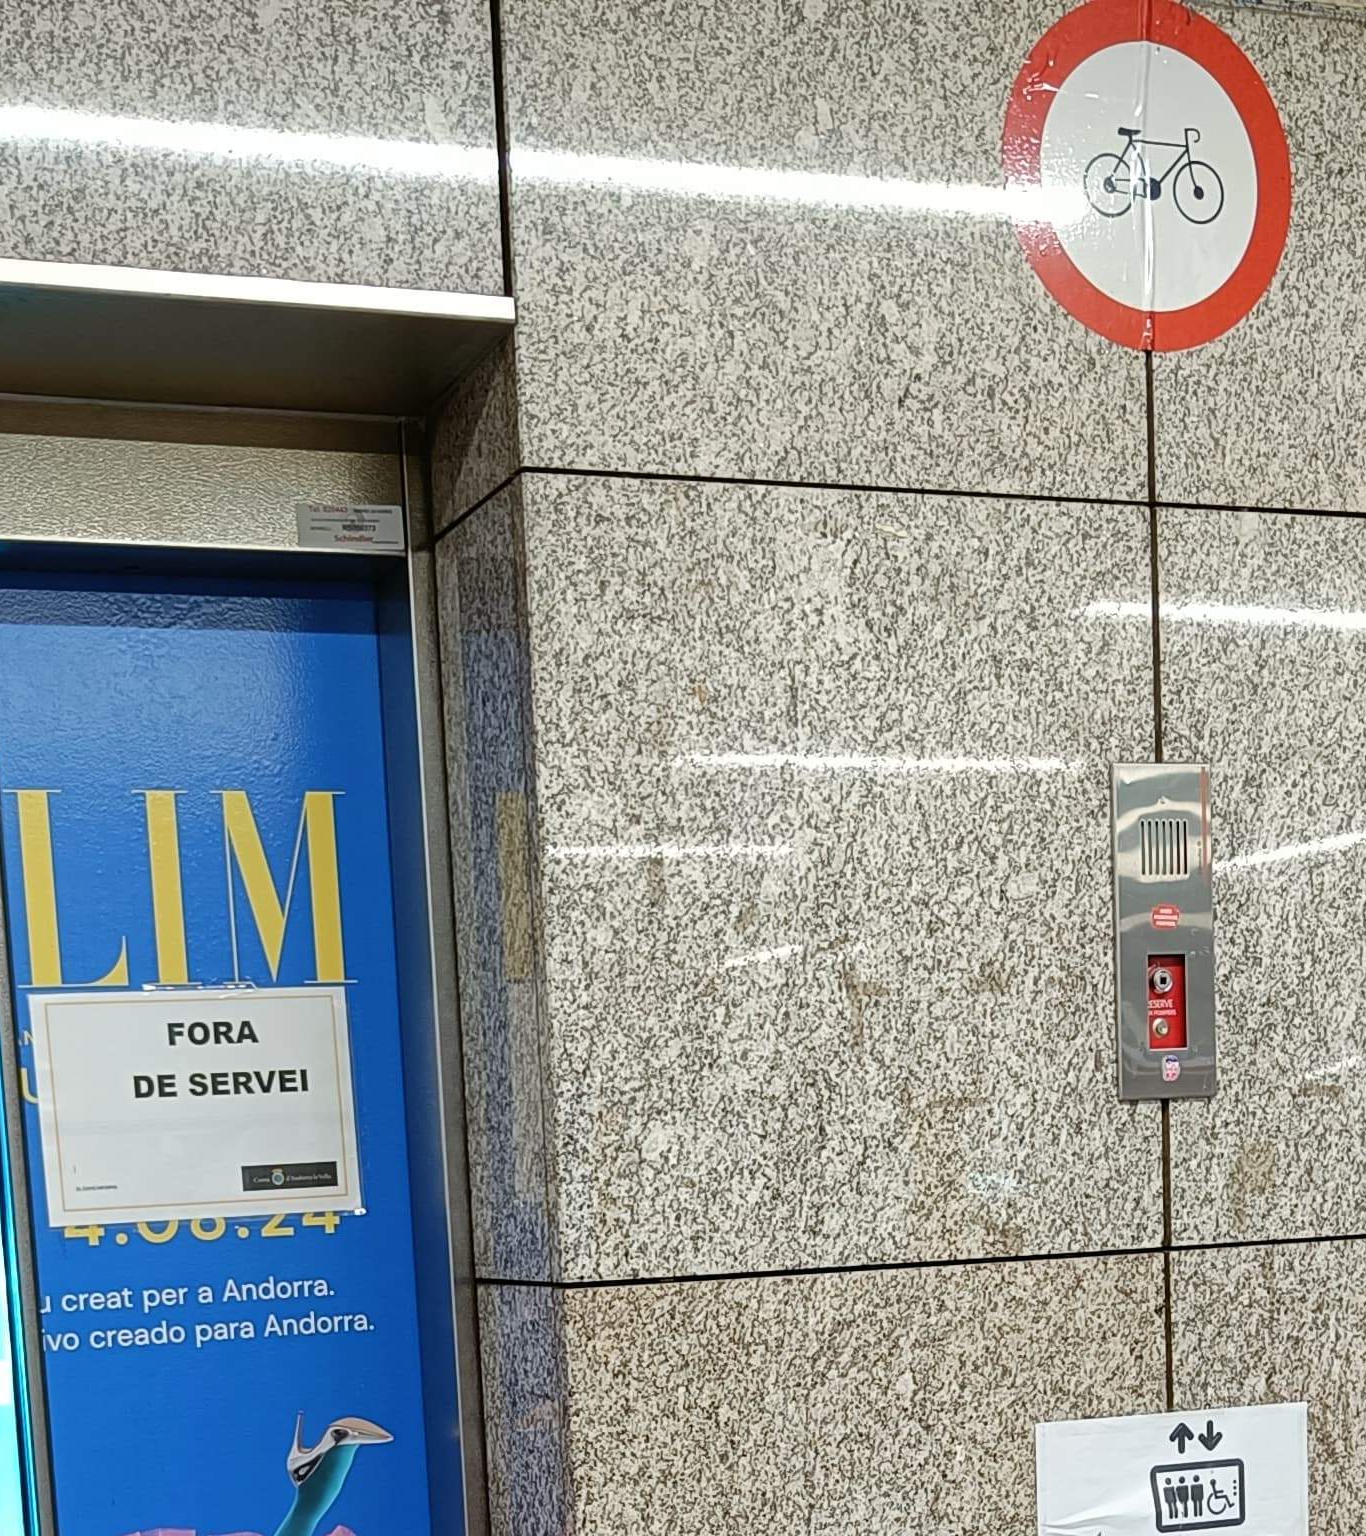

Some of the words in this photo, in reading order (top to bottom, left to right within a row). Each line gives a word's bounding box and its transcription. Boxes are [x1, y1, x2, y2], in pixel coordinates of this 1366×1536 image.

[166, 1020, 259, 1046] FORA
[133, 1073, 178, 1099] DE
[188, 1069, 309, 1097] SERVEI
[61, 1287, 133, 1312] creat
[143, 1285, 188, 1313] per
[198, 1285, 214, 1305] a
[222, 1276, 335, 1303] Andorra.
[90, 1320, 185, 1348] creado
[195, 1320, 255, 1348] para
[263, 1311, 375, 1338] Andorra.
